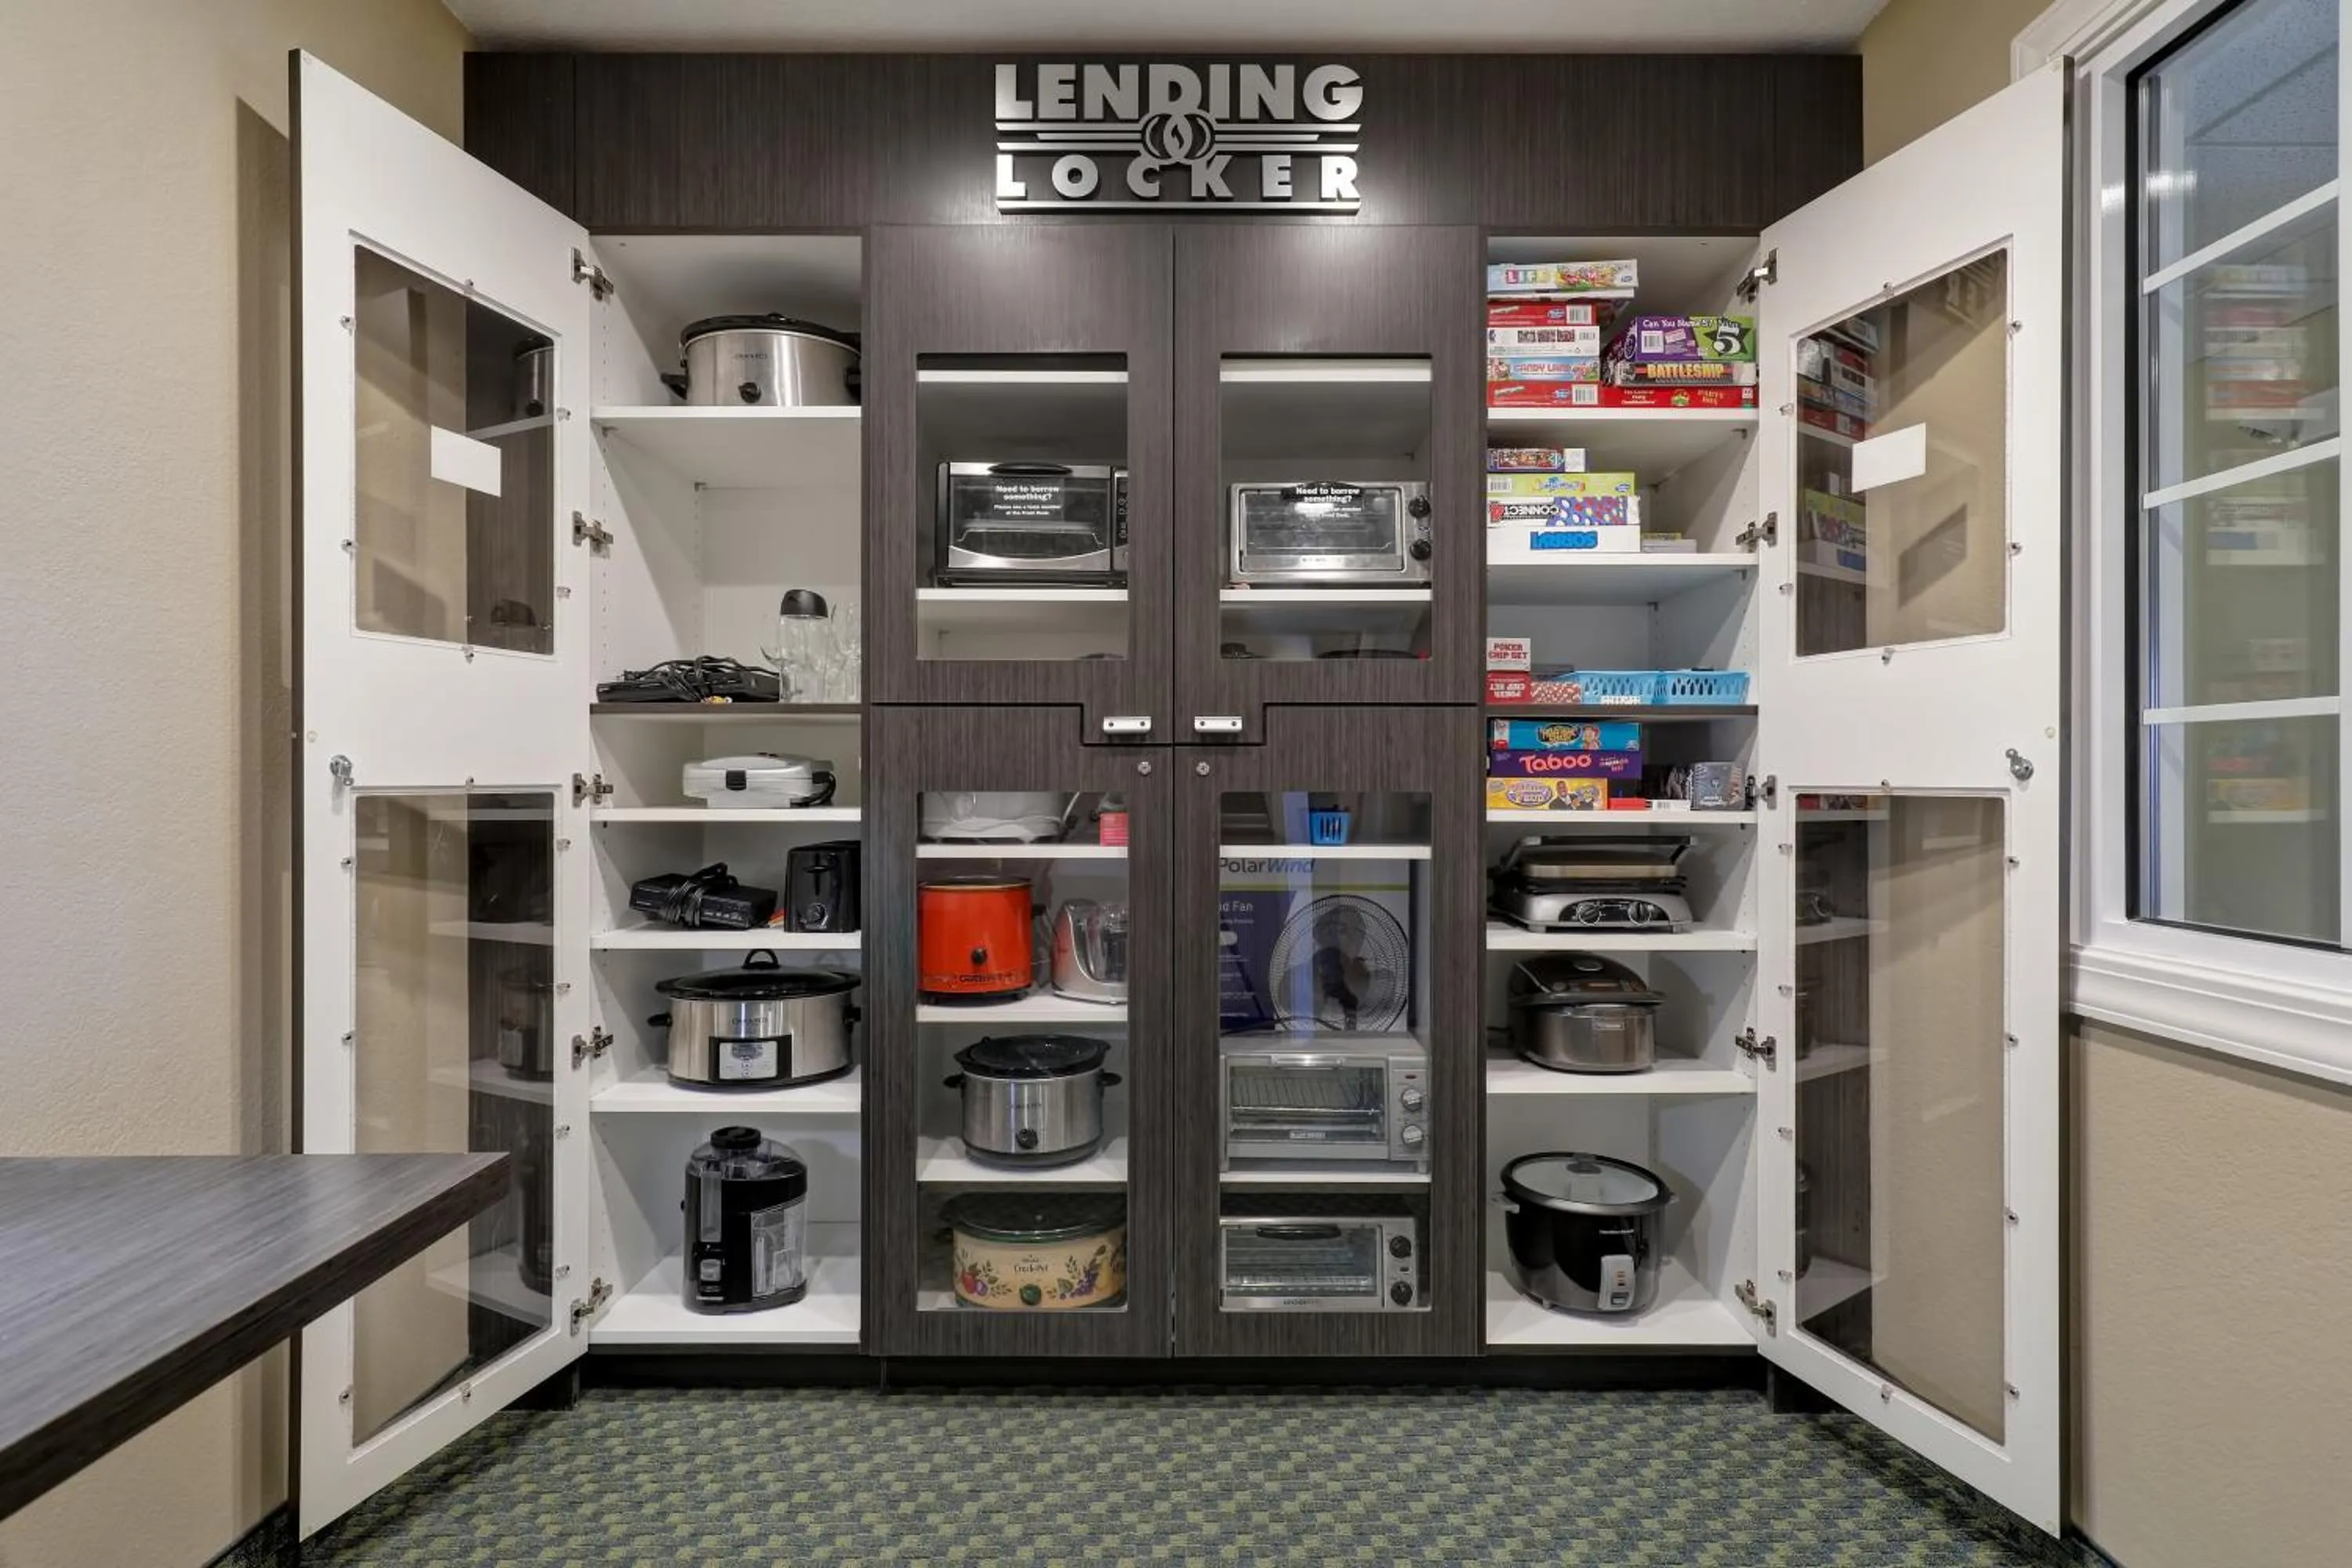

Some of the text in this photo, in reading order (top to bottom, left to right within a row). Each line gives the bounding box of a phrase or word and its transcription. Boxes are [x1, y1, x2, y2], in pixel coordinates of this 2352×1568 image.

[995, 64, 1364, 120] LENDING
[996, 154, 1361, 199] LOCKER
[1642, 319, 1660, 328] Can
[1712, 325, 1741, 355] 5
[1647, 363, 1724, 379] BATTLESHIP
[1019, 485, 1029, 493] to
[1004, 493, 1052, 502] something?
[1304, 495, 1352, 504] something?
[1504, 505, 1560, 516] CONNECT
[1519, 753, 1592, 774] Taboo
[1233, 901, 1254, 912] Fan
